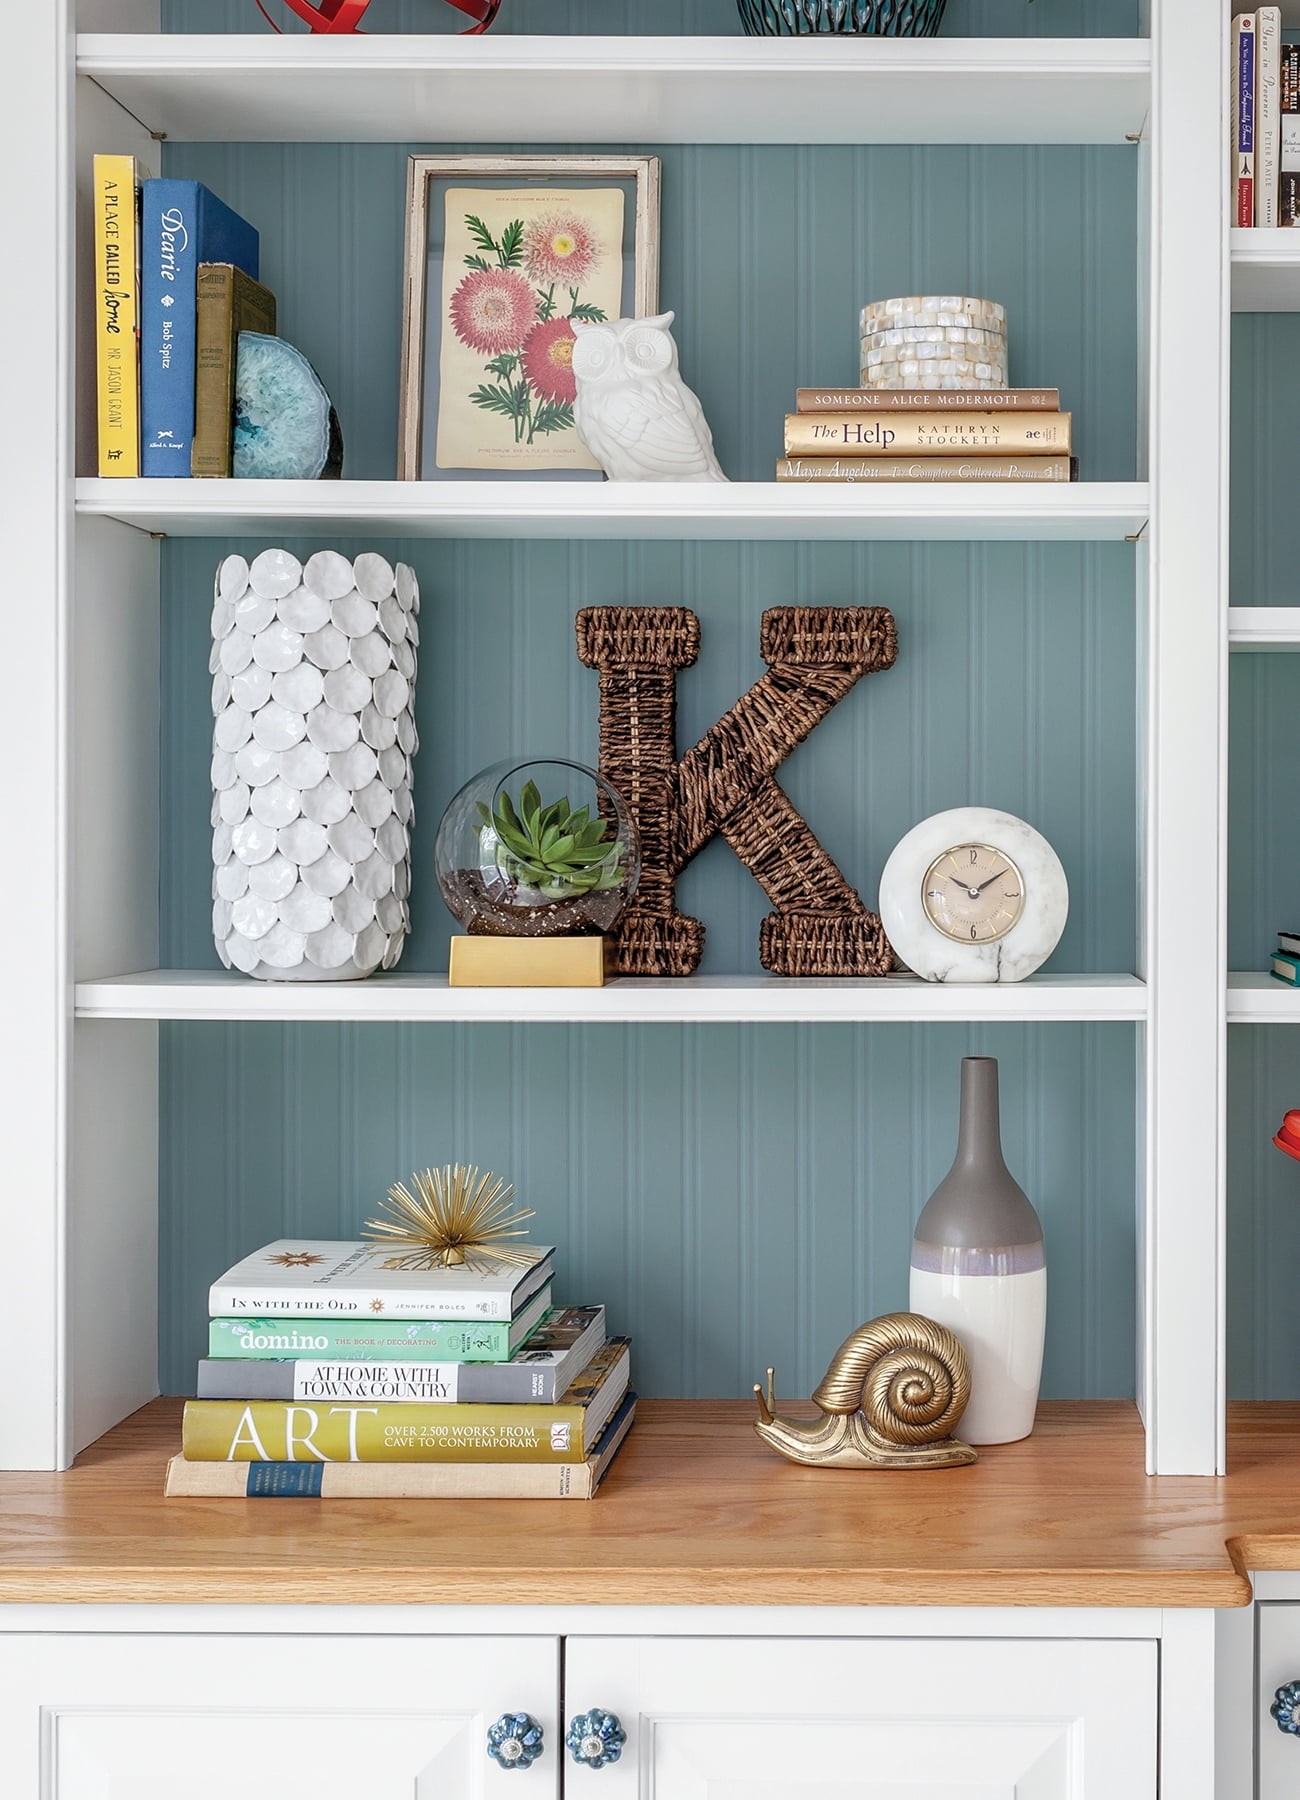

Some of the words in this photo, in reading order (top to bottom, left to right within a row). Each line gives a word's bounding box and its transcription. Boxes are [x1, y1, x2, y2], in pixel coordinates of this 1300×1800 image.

[1262, 11, 1274, 21] A
[1263, 27, 1274, 52] Year
[1263, 59, 1271, 68] in
[1263, 76, 1275, 118] Provence
[1290, 92, 1298, 110] WALK
[104, 180, 118, 191] A
[105, 195, 119, 239] PLACE
[161, 208, 189, 281] Dearie
[106, 244, 121, 285] CALLED
[103, 288, 130, 334] home
[162, 321, 174, 341] Bob
[107, 347, 122, 360] MR
[159, 343, 173, 369] Spitz
[107, 366, 122, 394] JASON
[815, 395, 880, 405] SOMEONE
[891, 395, 930, 405] ALICE
[938, 395, 1019, 405] McDERMOTT
[108, 398, 123, 429] GRANT
[812, 425, 838, 438] The
[842, 422, 895, 449] Help
[918, 425, 1000, 433] KATHRYN
[1026, 430, 1041, 439] ae
[917, 436, 1000, 444] STOCKETT
[784, 461, 823, 482] Maya
[828, 461, 880, 482] Angelou
[908, 464, 953, 482] Complete
[958, 464, 1001, 478] Collected
[1007, 464, 1039, 478] Poems
[969, 850, 978, 864] 12
[970, 924, 977, 939] 6
[232, 1297, 247, 1308] IN
[252, 1301, 290, 1309] WITH
[294, 1301, 324, 1309] THE
[328, 1299, 357, 1310] OLD
[240, 1330, 329, 1350] domino
[312, 1367, 335, 1381] AT
[337, 1367, 388, 1381] HOME
[393, 1367, 440, 1382] WITH
[301, 1382, 352, 1396] TOWN
[356, 1383, 367, 1396] &
[371, 1382, 451, 1397] COUNTRY
[226, 1406, 378, 1461] ART
[384, 1426, 417, 1436] OVER
[451, 1426, 496, 1436] WORKS
[499, 1426, 535, 1436] FROM
[552, 1426, 568, 1449] DK
[384, 1437, 414, 1447] CAVE
[418, 1437, 435, 1447] TO
[439, 1437, 540, 1447] CONTEMPORARY
